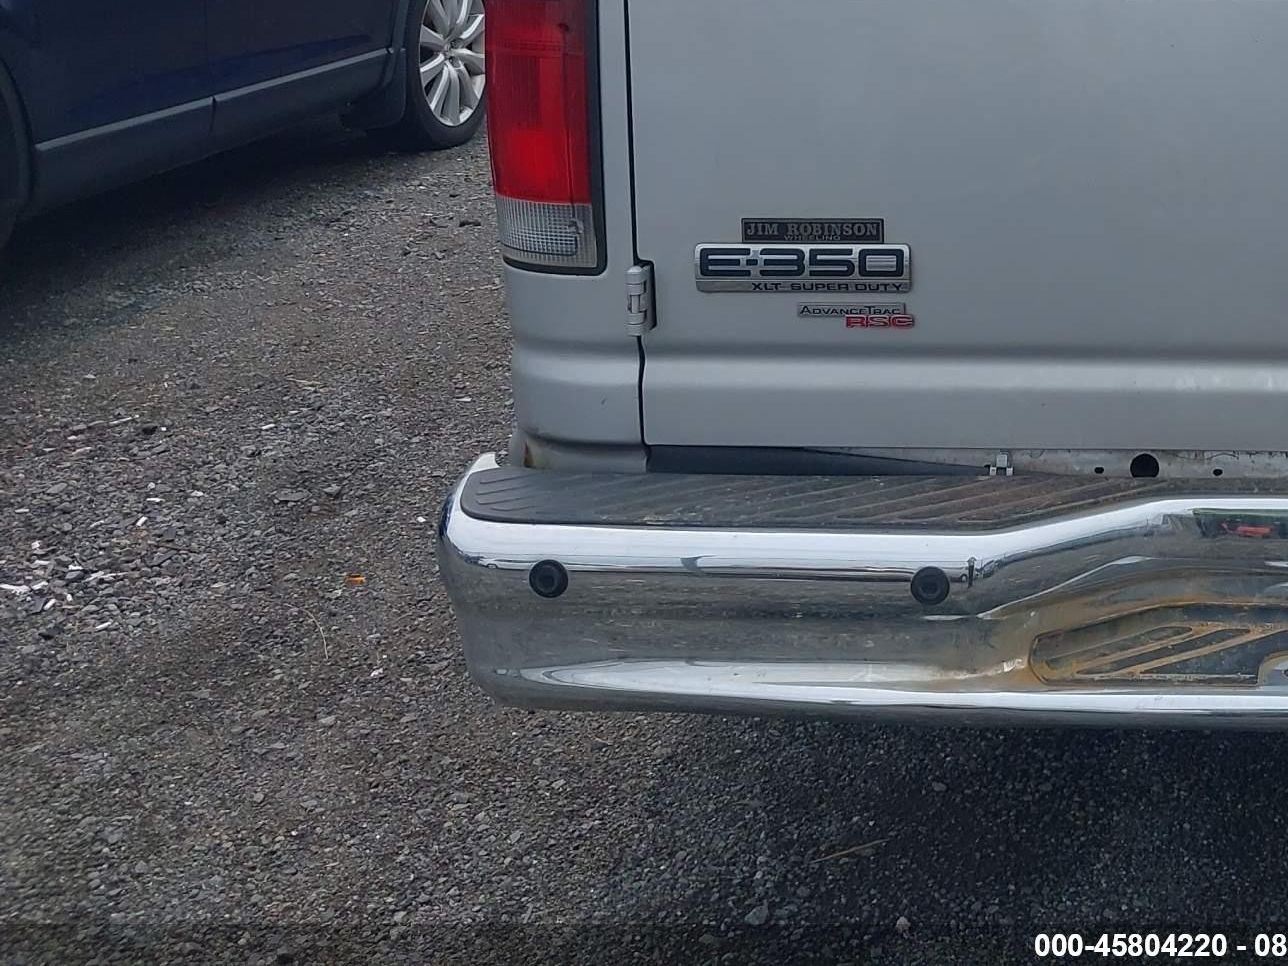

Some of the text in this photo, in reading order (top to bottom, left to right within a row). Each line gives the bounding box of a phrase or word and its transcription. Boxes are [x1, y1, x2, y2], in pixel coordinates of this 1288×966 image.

[747, 223, 878, 236] JIM ROBINSON
[699, 247, 905, 278] E-350
[752, 282, 903, 291] XLT SUPER DUTY
[845, 315, 913, 328] RSC
